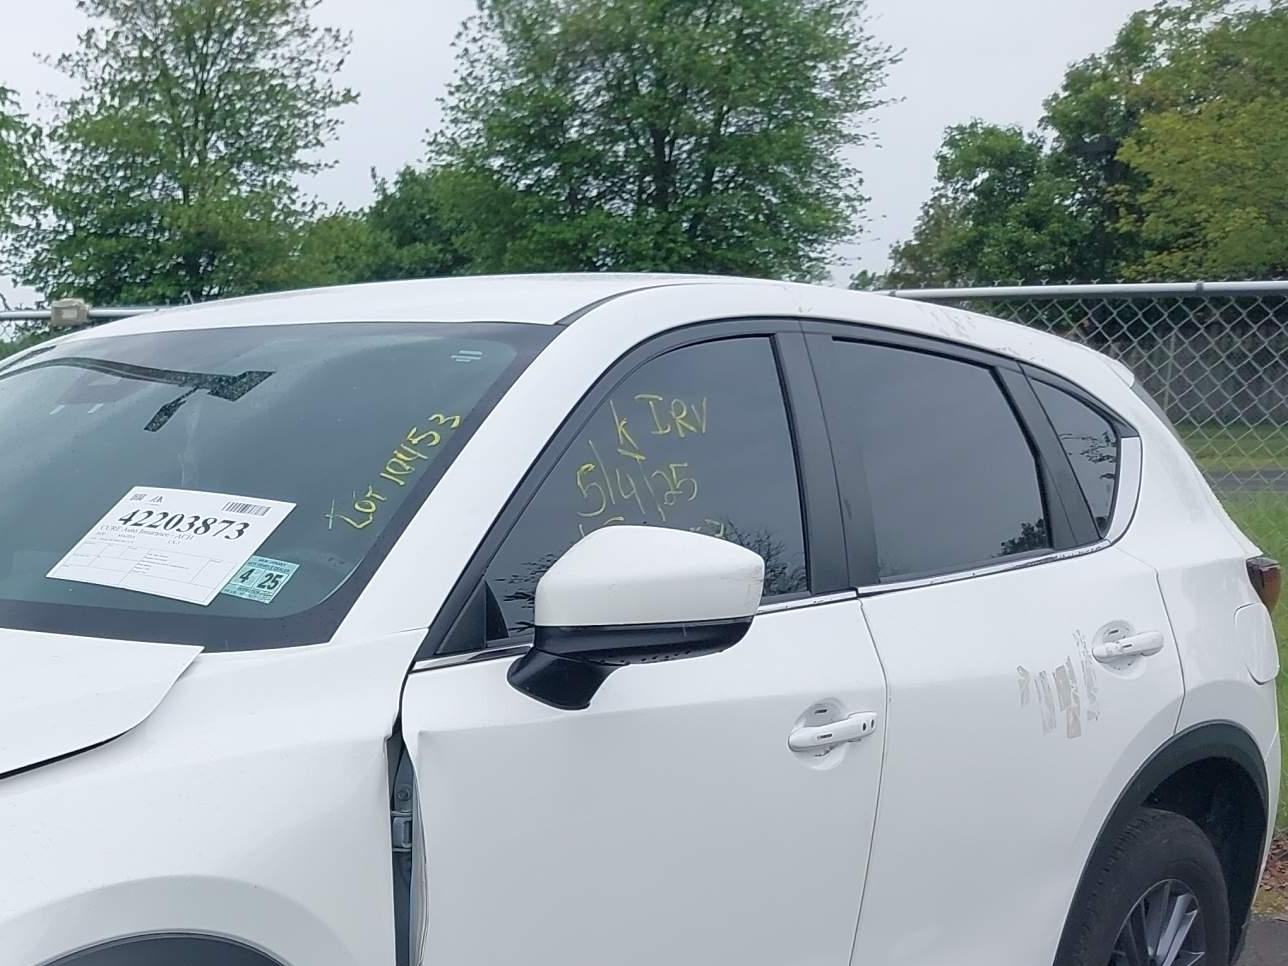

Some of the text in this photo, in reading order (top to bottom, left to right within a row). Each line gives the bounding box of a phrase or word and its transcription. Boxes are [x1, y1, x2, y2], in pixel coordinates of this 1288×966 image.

[117, 508, 251, 541] 42203873
[239, 568, 284, 590] 4 25
